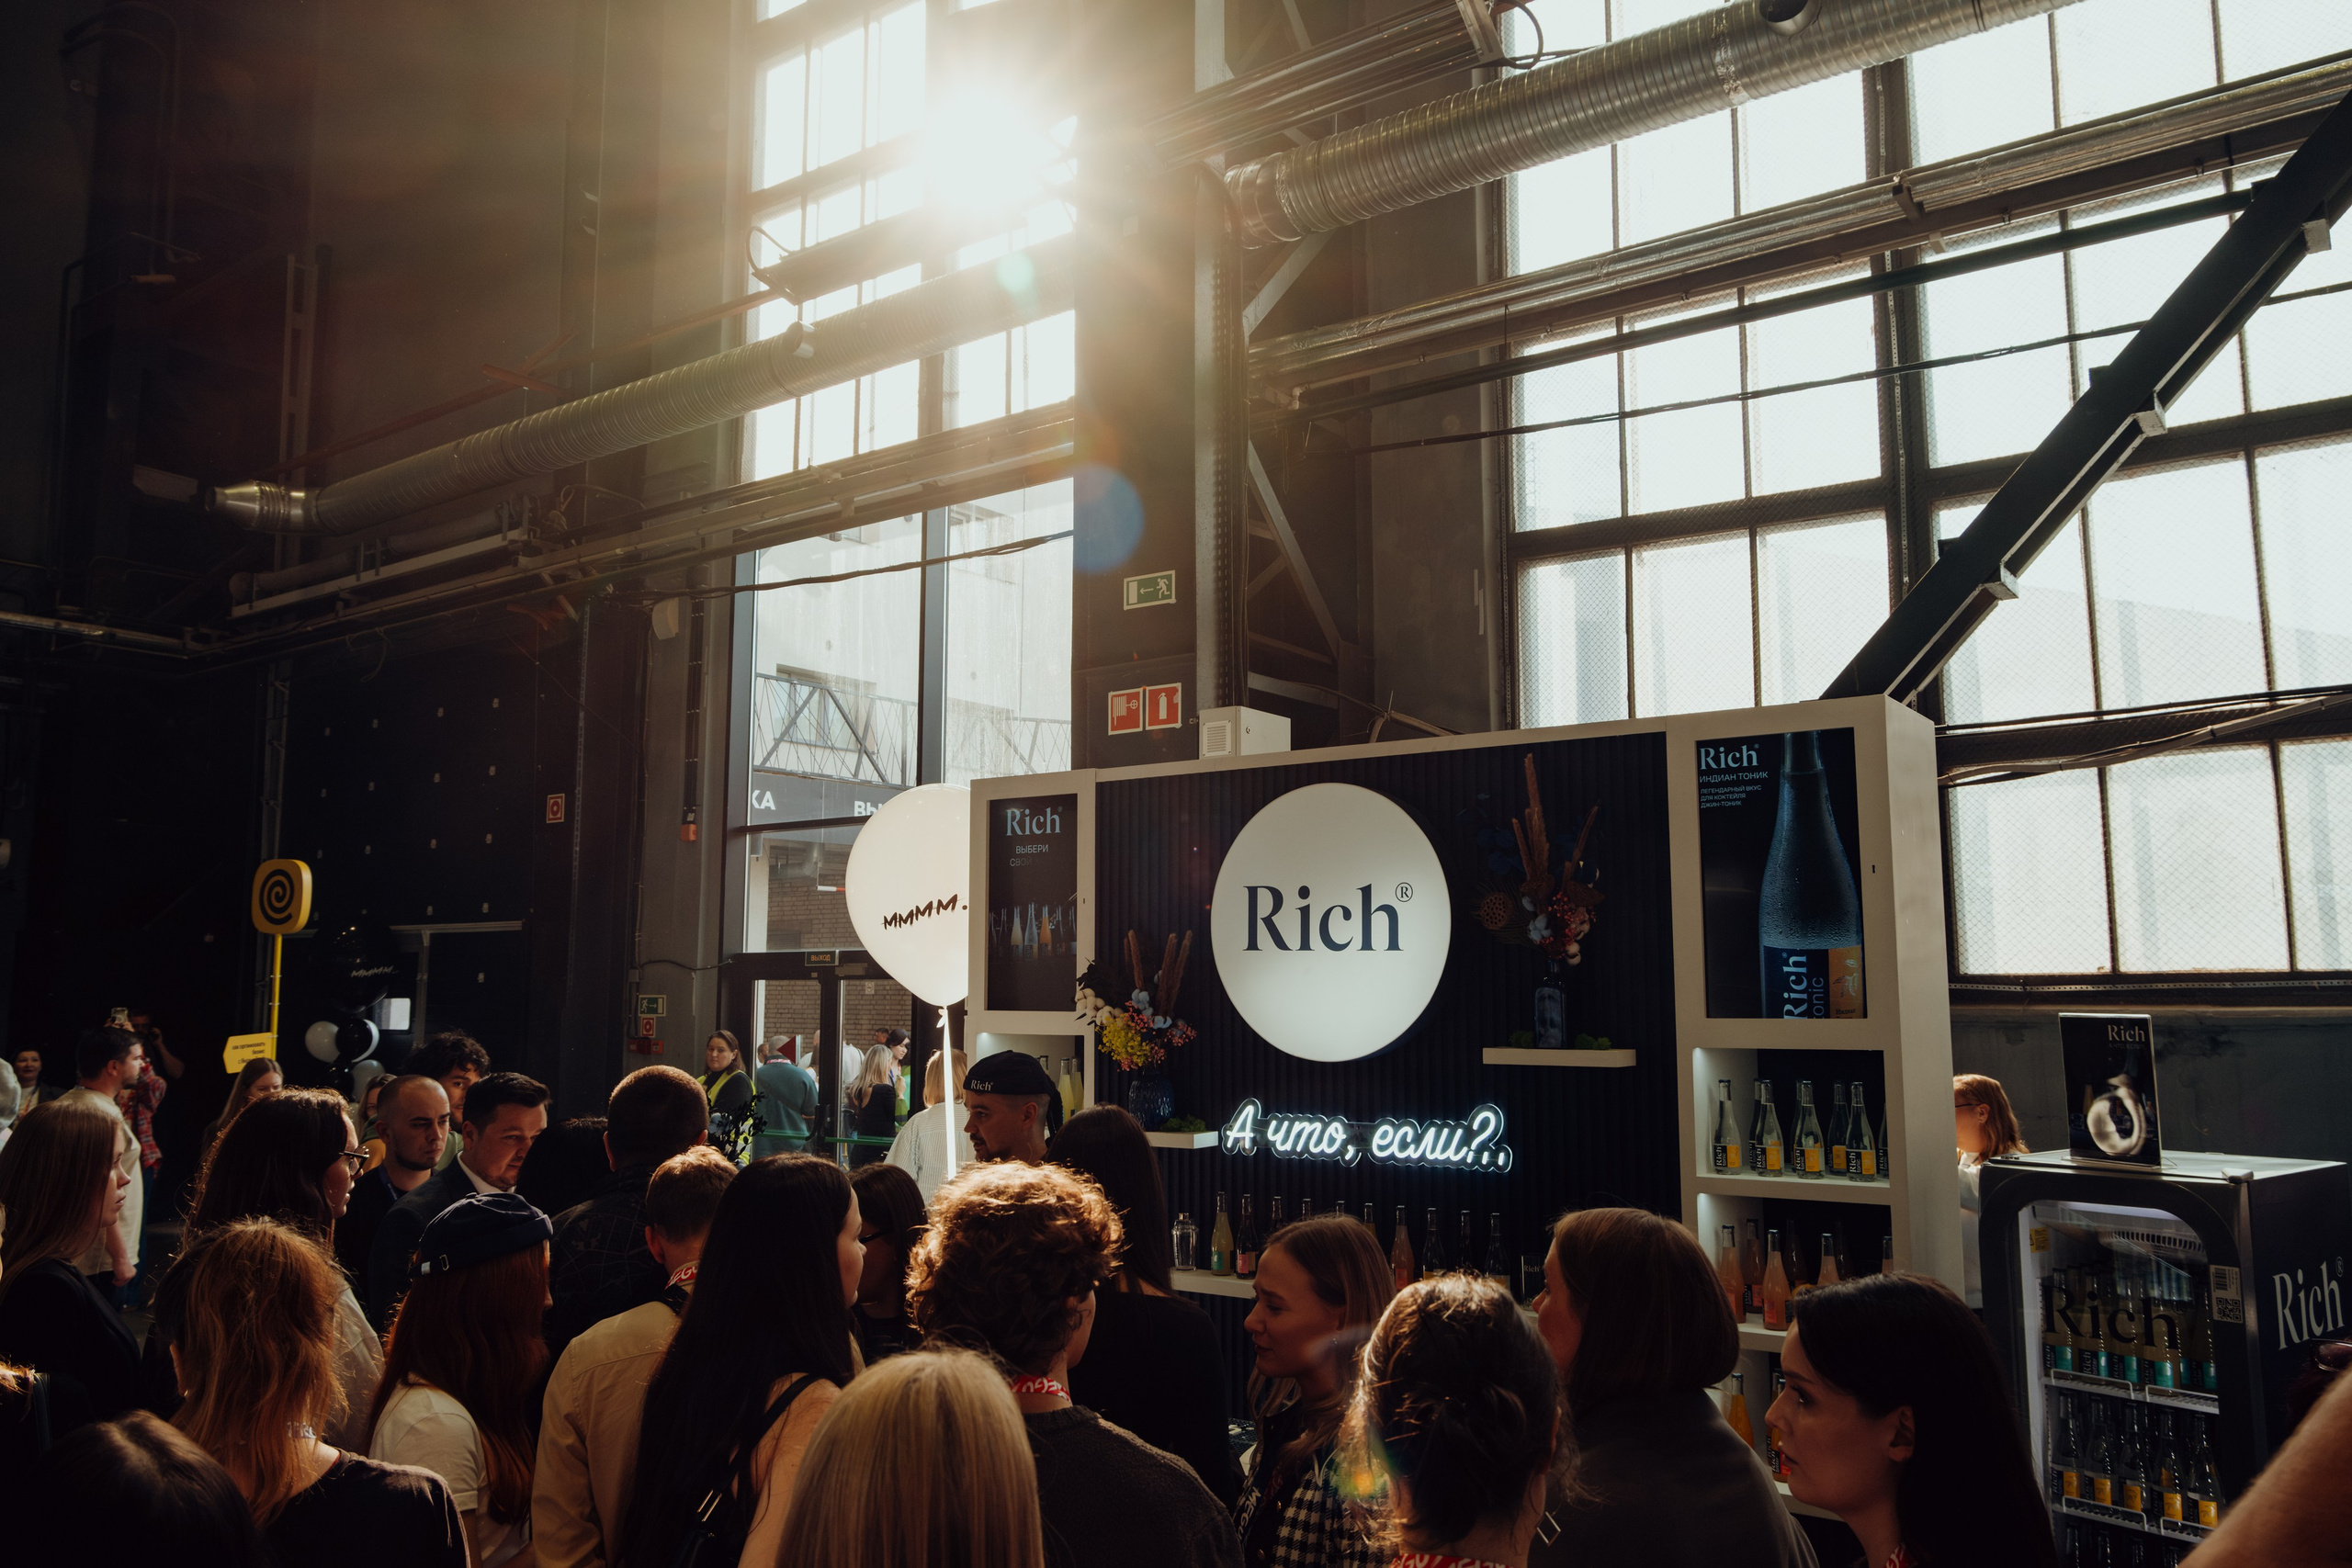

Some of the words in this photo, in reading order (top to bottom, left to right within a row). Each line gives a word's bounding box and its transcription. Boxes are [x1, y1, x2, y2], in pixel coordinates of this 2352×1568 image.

[1699, 773, 1736, 783] ИНДИАН
[1738, 772, 1769, 780] ТОНИК
[1701, 785, 1745, 794] ЛЕГЕНДАРНЫЙ
[1015, 844, 1049, 854] ВЫБЕРИ
[1808, 977, 1825, 1019] onic
[2108, 1024, 2146, 1042] Rich
[1227, 1104, 1259, 1148] А
